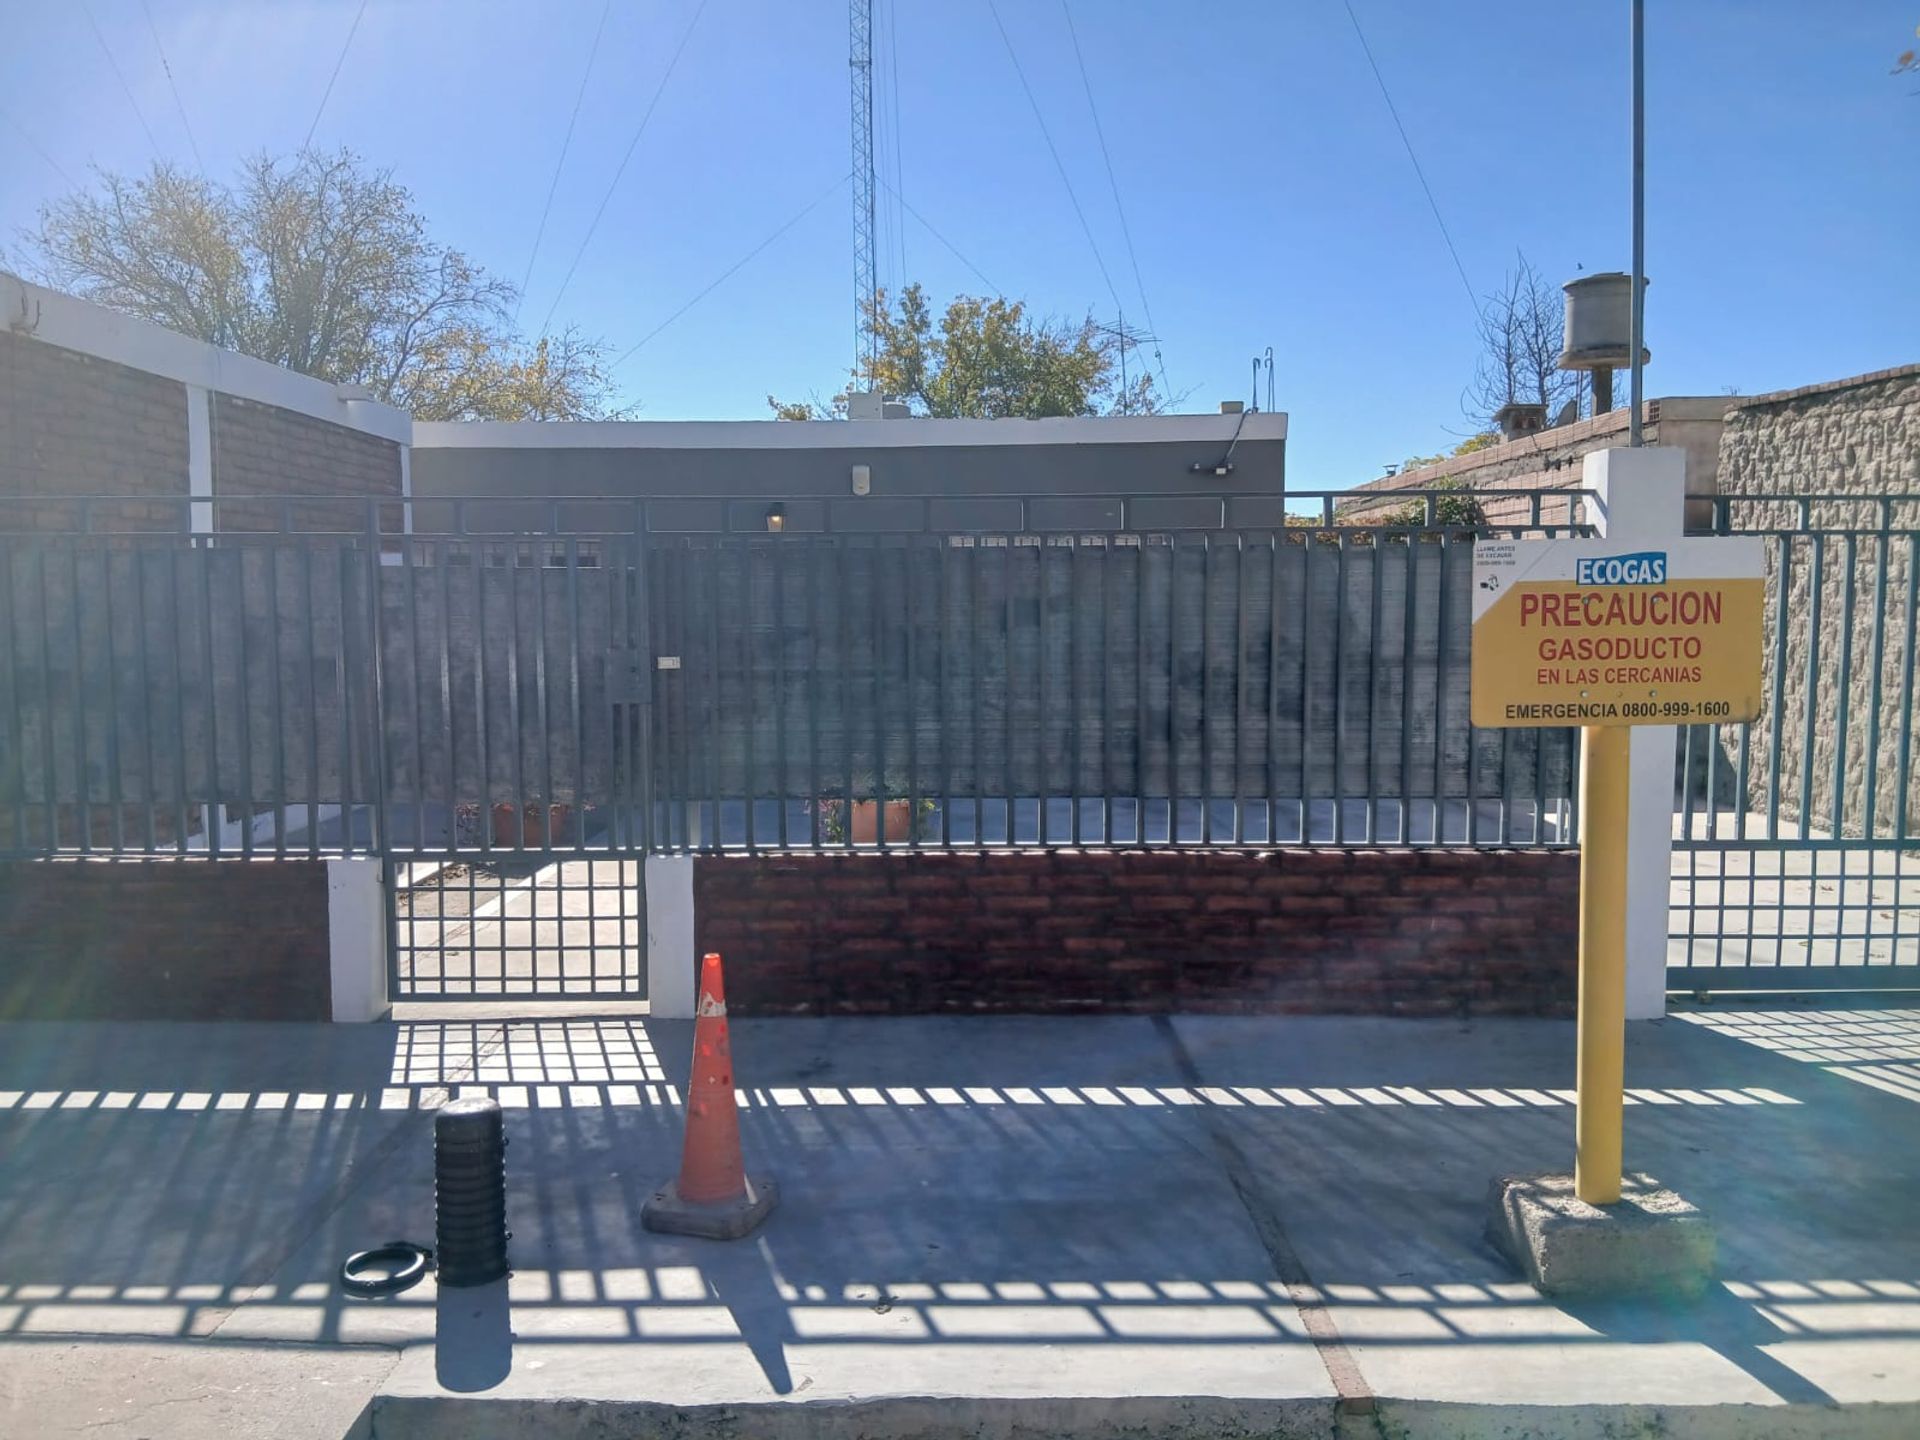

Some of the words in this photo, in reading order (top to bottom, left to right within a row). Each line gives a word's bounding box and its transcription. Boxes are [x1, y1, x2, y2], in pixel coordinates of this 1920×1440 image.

[1579, 559, 1665, 585] ECOGAS
[1520, 591, 1722, 627] PRECAUCION
[1538, 636, 1702, 661] GASODUCTO
[1537, 668, 1559, 685] EN
[1565, 668, 1598, 684] LAS
[1604, 666, 1702, 684] CERCANIAS
[1505, 703, 1618, 719] EMERGENCIA
[1622, 701, 1730, 718] 0800-999-1600
